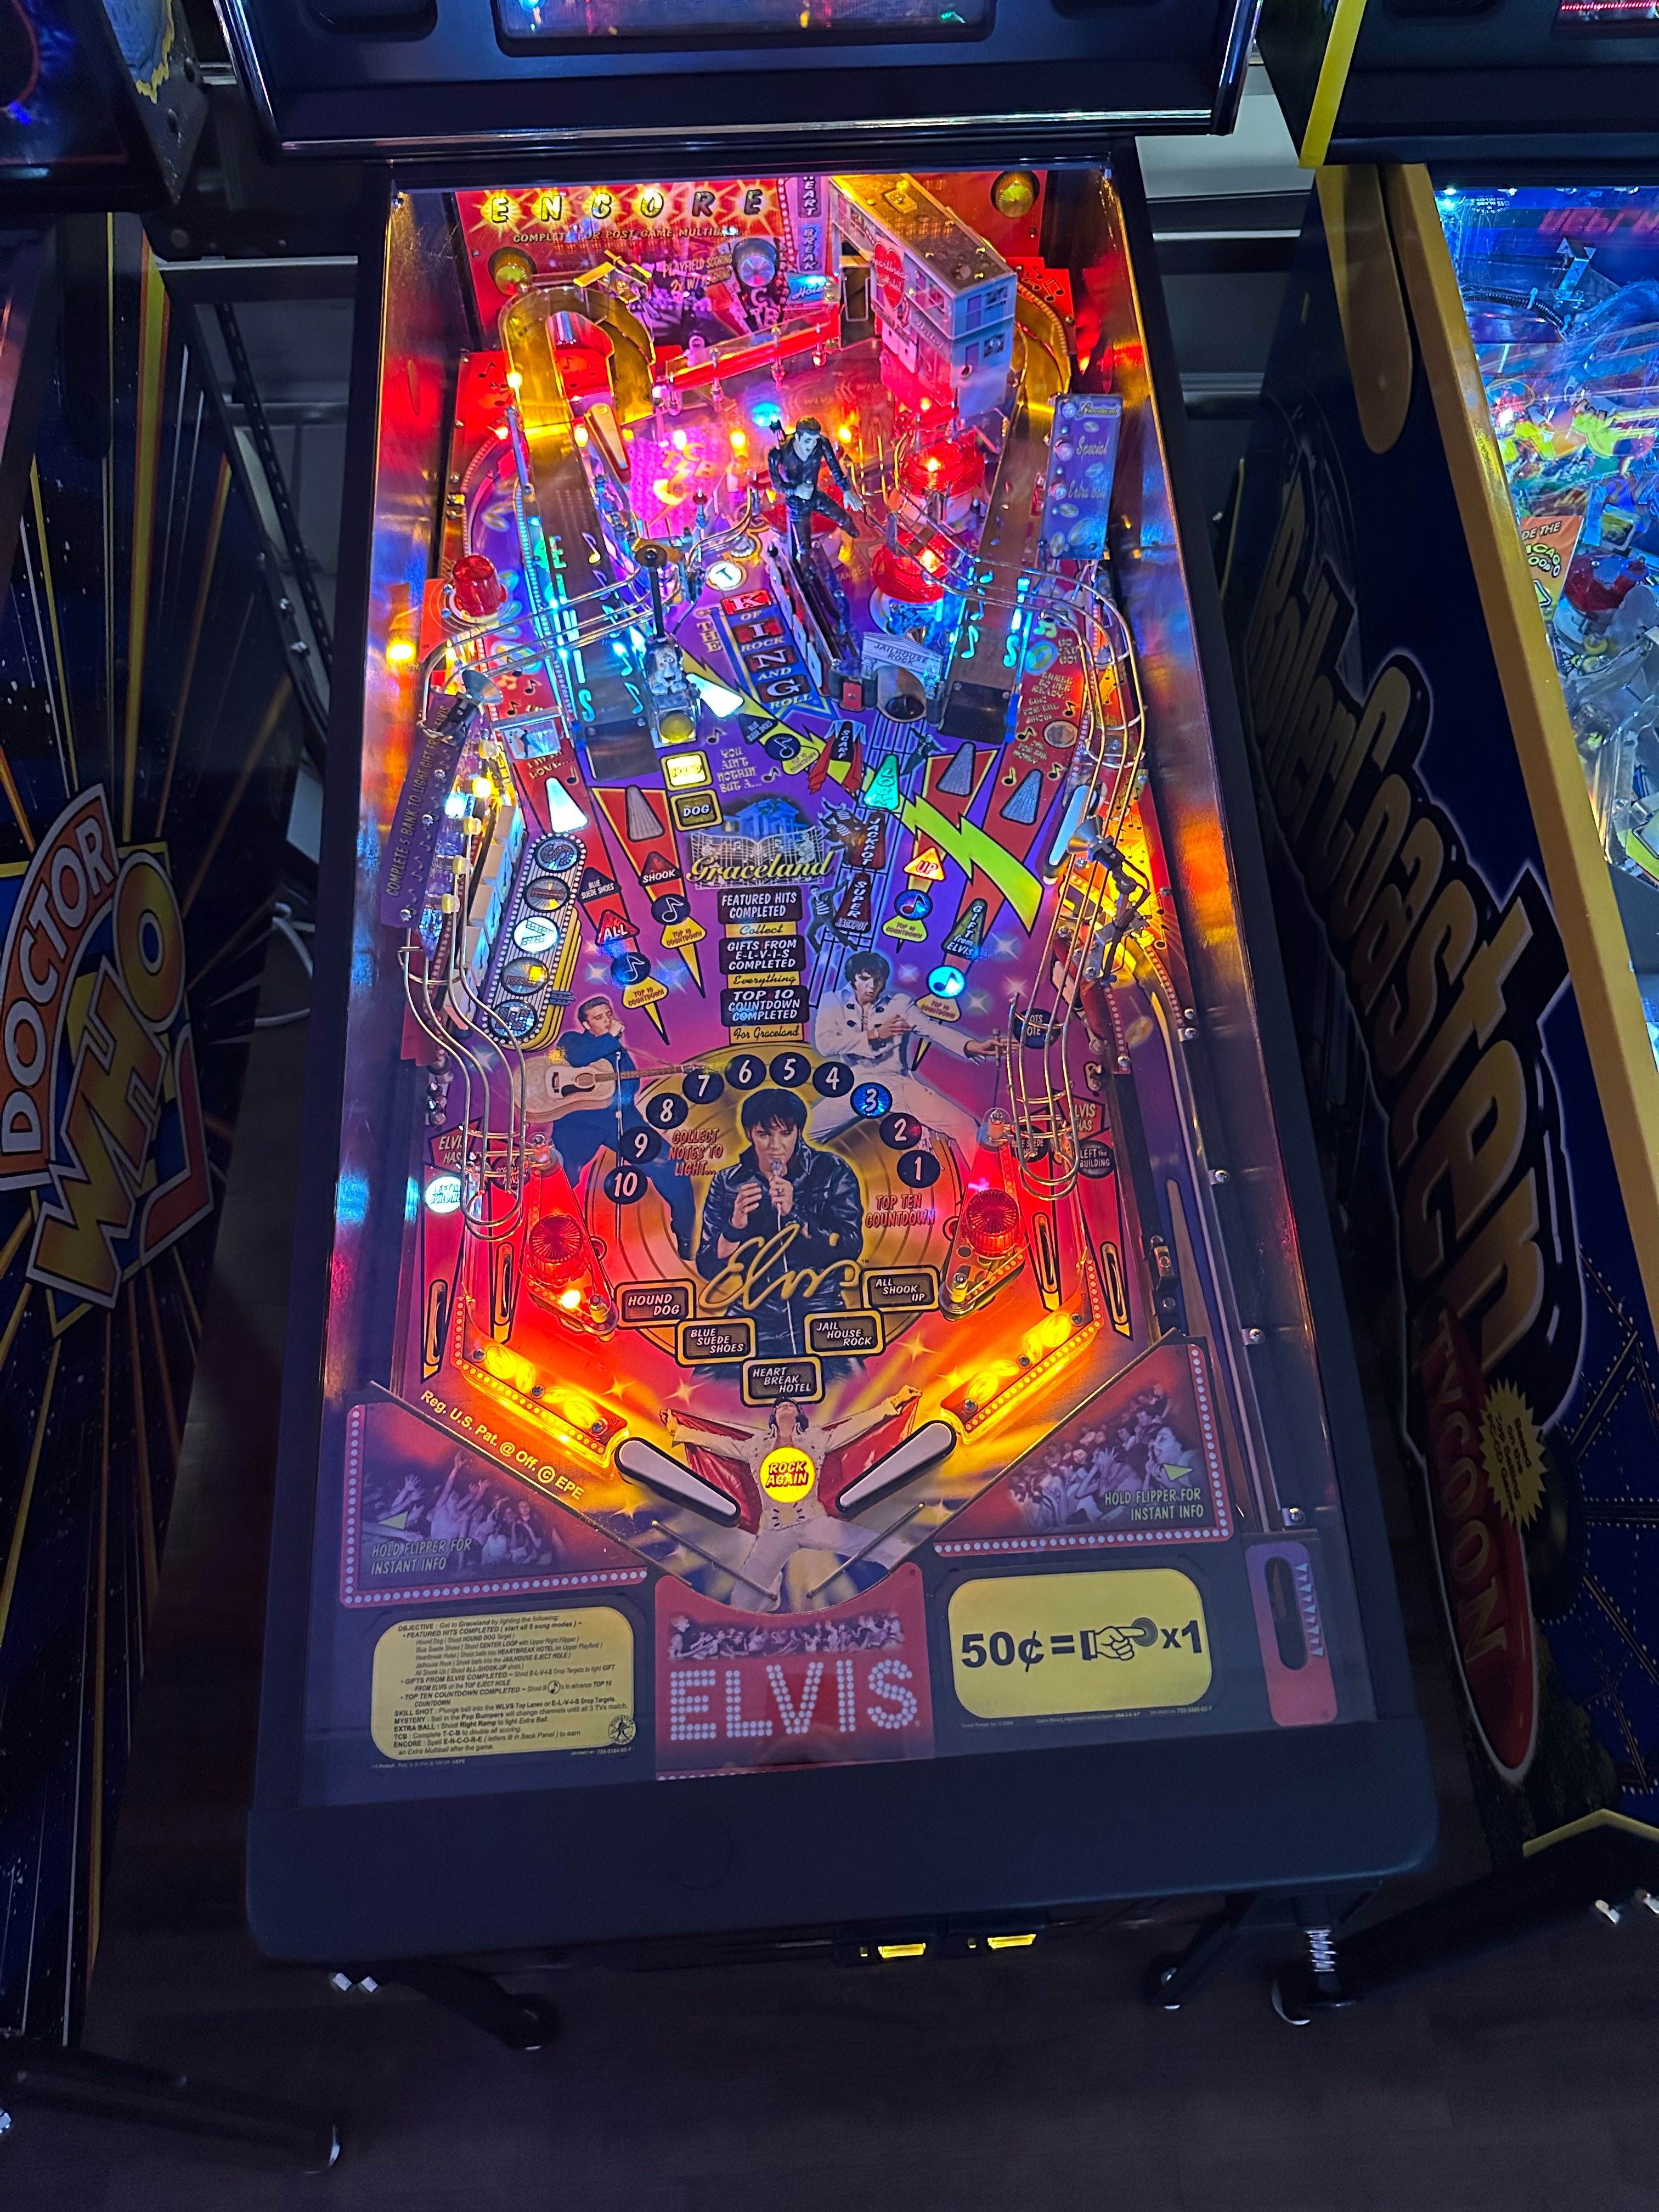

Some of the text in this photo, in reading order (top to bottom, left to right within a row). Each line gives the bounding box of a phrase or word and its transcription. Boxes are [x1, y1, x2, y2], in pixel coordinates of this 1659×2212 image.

[641, 229, 673, 238] GAME
[803, 228, 817, 270] BREAK
[663, 260, 704, 278] PLAYFIELD
[1076, 436, 1110, 463] Special
[1539, 521, 1561, 535] THE
[741, 610, 762, 620] OF
[697, 621, 724, 653] THE
[741, 637, 785, 652] ROCK
[873, 641, 927, 664] JAILHOUSE
[888, 651, 916, 667] ROCK
[758, 667, 792, 681] AND
[770, 693, 812, 709] ROLL
[838, 729, 851, 759] SCARF
[420, 750, 435, 768] GIFT
[720, 747, 743, 759] YOU
[412, 769, 428, 793] LIGHT
[719, 781, 741, 793] BUT
[408, 796, 422, 808] TO
[683, 804, 710, 817] DOG
[400, 809, 417, 836] BANK
[861, 817, 881, 865] JACKPOT
[386, 847, 409, 896] COMPLETE
[686, 847, 836, 882] Graceland
[916, 860, 939, 874] UP
[643, 869, 675, 883] SHOOK
[581, 883, 614, 899] SUEDE SHOES
[588, 879, 601, 889] BLUE
[721, 892, 797, 907] FEATURED HITS
[847, 881, 867, 918] SUPER
[729, 905, 786, 918] COMPLETED
[740, 924, 783, 935] Collect
[965, 905, 983, 939] GIFT
[603, 923, 629, 939] ALL
[667, 930, 702, 946] COUNTDOWN
[672, 929, 684, 938] TOP
[727, 939, 797, 952] GIFTS FROM
[953, 934, 974, 946] from
[735, 949, 790, 959] E-L-V-I-S
[947, 942, 975, 956] ELVIS
[729, 959, 796, 970] COMPLETED
[2, 815, 116, 1153] DOCTOR
[733, 974, 797, 986] Everything
[628, 988, 664, 1006] COUNTDOWN
[633, 989, 647, 998] TOP
[733, 989, 794, 1001] TOP 10
[728, 1000, 800, 1012] COUNTDOWN
[732, 1009, 798, 1022] COMPLETED
[733, 1024, 799, 1040] For Graceland
[30, 850, 184, 1303] WHO
[739, 1060, 752, 1082] 6
[785, 1059, 796, 1080] 5
[697, 1075, 709, 1097] 7
[826, 1068, 839, 1090] 4
[865, 1088, 878, 1112] 3
[660, 1099, 673, 1122] 8
[1074, 1103, 1096, 1118] LVIS
[673, 1128, 719, 1145] COLLECT
[893, 1119, 907, 1142] 2
[635, 1133, 648, 1157] 9
[669, 1142, 723, 1160] NOTES TO
[1080, 1148, 1097, 1159] LEFT
[914, 1158, 922, 1180] 1
[1079, 1158, 1110, 1168] BUILDING
[615, 1172, 637, 1195] 10
[877, 1194, 922, 1210] TOP TEN
[866, 1210, 936, 1228] COUNTDOWN
[875, 1278, 894, 1288] ALL
[882, 1284, 918, 1295] SHOOK
[628, 1293, 673, 1306] HOUND
[912, 1293, 926, 1302] UP
[653, 1304, 680, 1316] DOG
[690, 1328, 716, 1339] BLUE
[816, 1322, 839, 1331] JAIL
[826, 1329, 862, 1339] HOUSE
[696, 1335, 730, 1346] SUEDE
[709, 1343, 744, 1353] SHOES
[843, 1336, 872, 1346] ROCK
[752, 1367, 788, 1378] HEART
[763, 1375, 799, 1386] BREAK
[778, 1383, 811, 1393] HOTEL
[420, 1390, 585, 1500] Reg. U.S. Pat. Off. EPE
[768, 1460, 807, 1475] ROCK
[765, 1472, 808, 1488] AGAIN
[1104, 1488, 1201, 1506] HOLD FLIPPER FOR
[1424, 1314, 1508, 1667] TYCOON
[1130, 1505, 1204, 1522] INSTANT INFO
[372, 1538, 472, 1558] HOLD FLIPPER FOR
[371, 1558, 447, 1575] INSTANT INFO
[398, 1623, 434, 1632] OBJECTIVE
[1162, 1620, 1203, 1654] x1
[479, 1687, 520, 1695] COMPLETED
[670, 1658, 918, 1741] ELVIS
